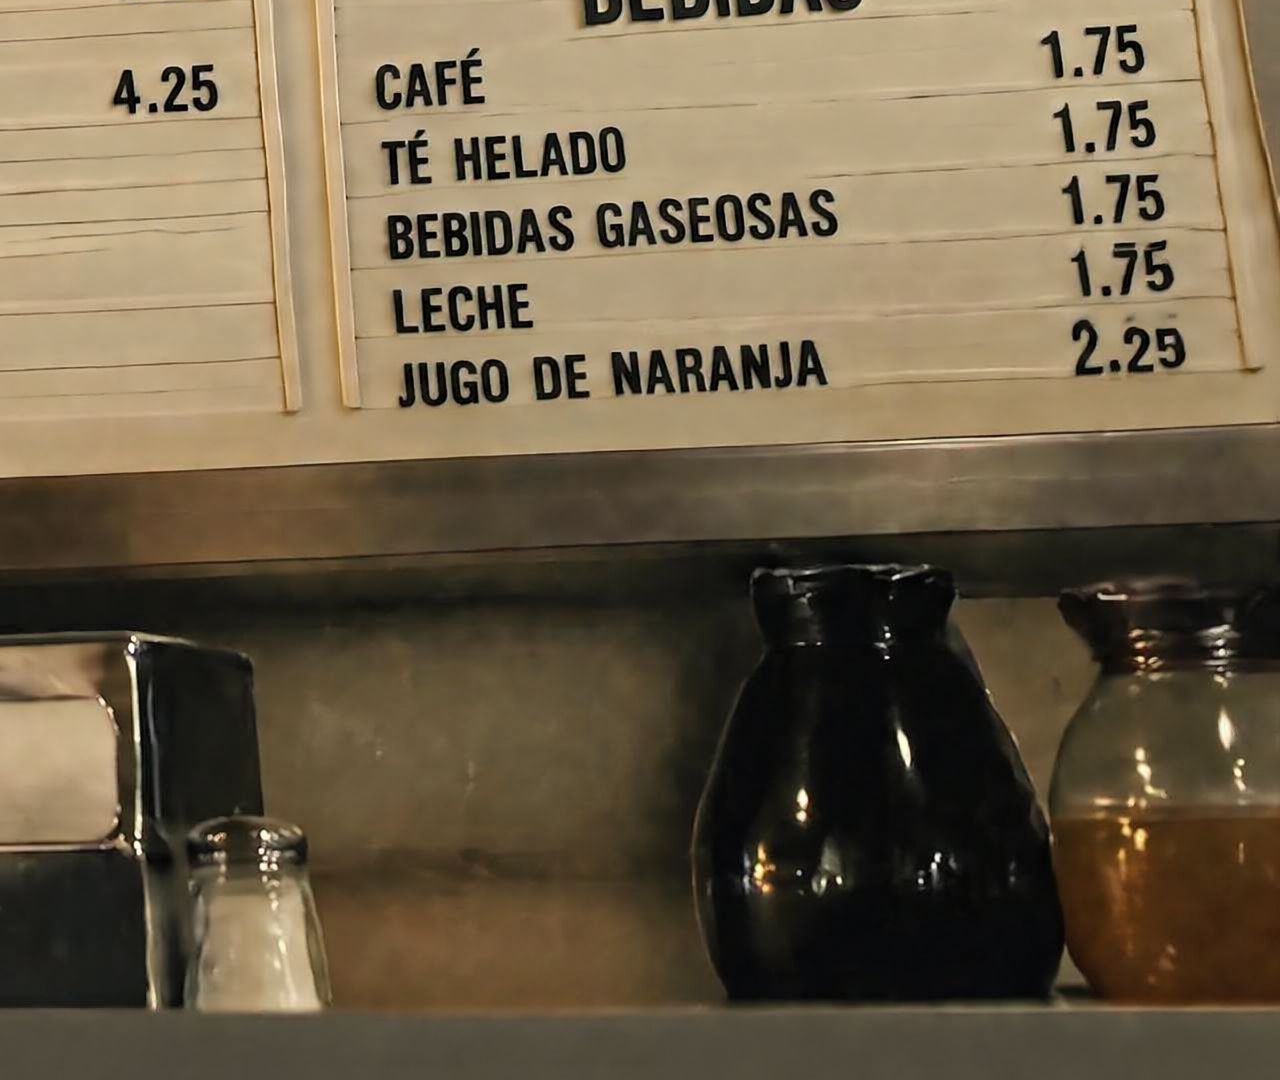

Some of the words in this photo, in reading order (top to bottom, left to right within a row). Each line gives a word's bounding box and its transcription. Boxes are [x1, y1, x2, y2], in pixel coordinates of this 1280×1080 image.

[111, 64, 219, 115] 4.25
[374, 47, 486, 111] CAFÉ
[1040, 24, 1145, 79] 1.75
[380, 129, 433, 186] TÉ
[453, 126, 627, 182] HELADO
[1053, 99, 1157, 154] 1.75
[387, 205, 575, 261] BEBIDAS
[595, 188, 839, 249] GASEOSAS
[1061, 173, 1165, 225] 1.75
[392, 283, 534, 334] LECHE
[1070, 239, 1175, 297] 1.75
[398, 358, 510, 409] JUGO
[532, 354, 591, 401] DE
[610, 339, 829, 397] NARANJA
[1071, 319, 1187, 377] 2.25
